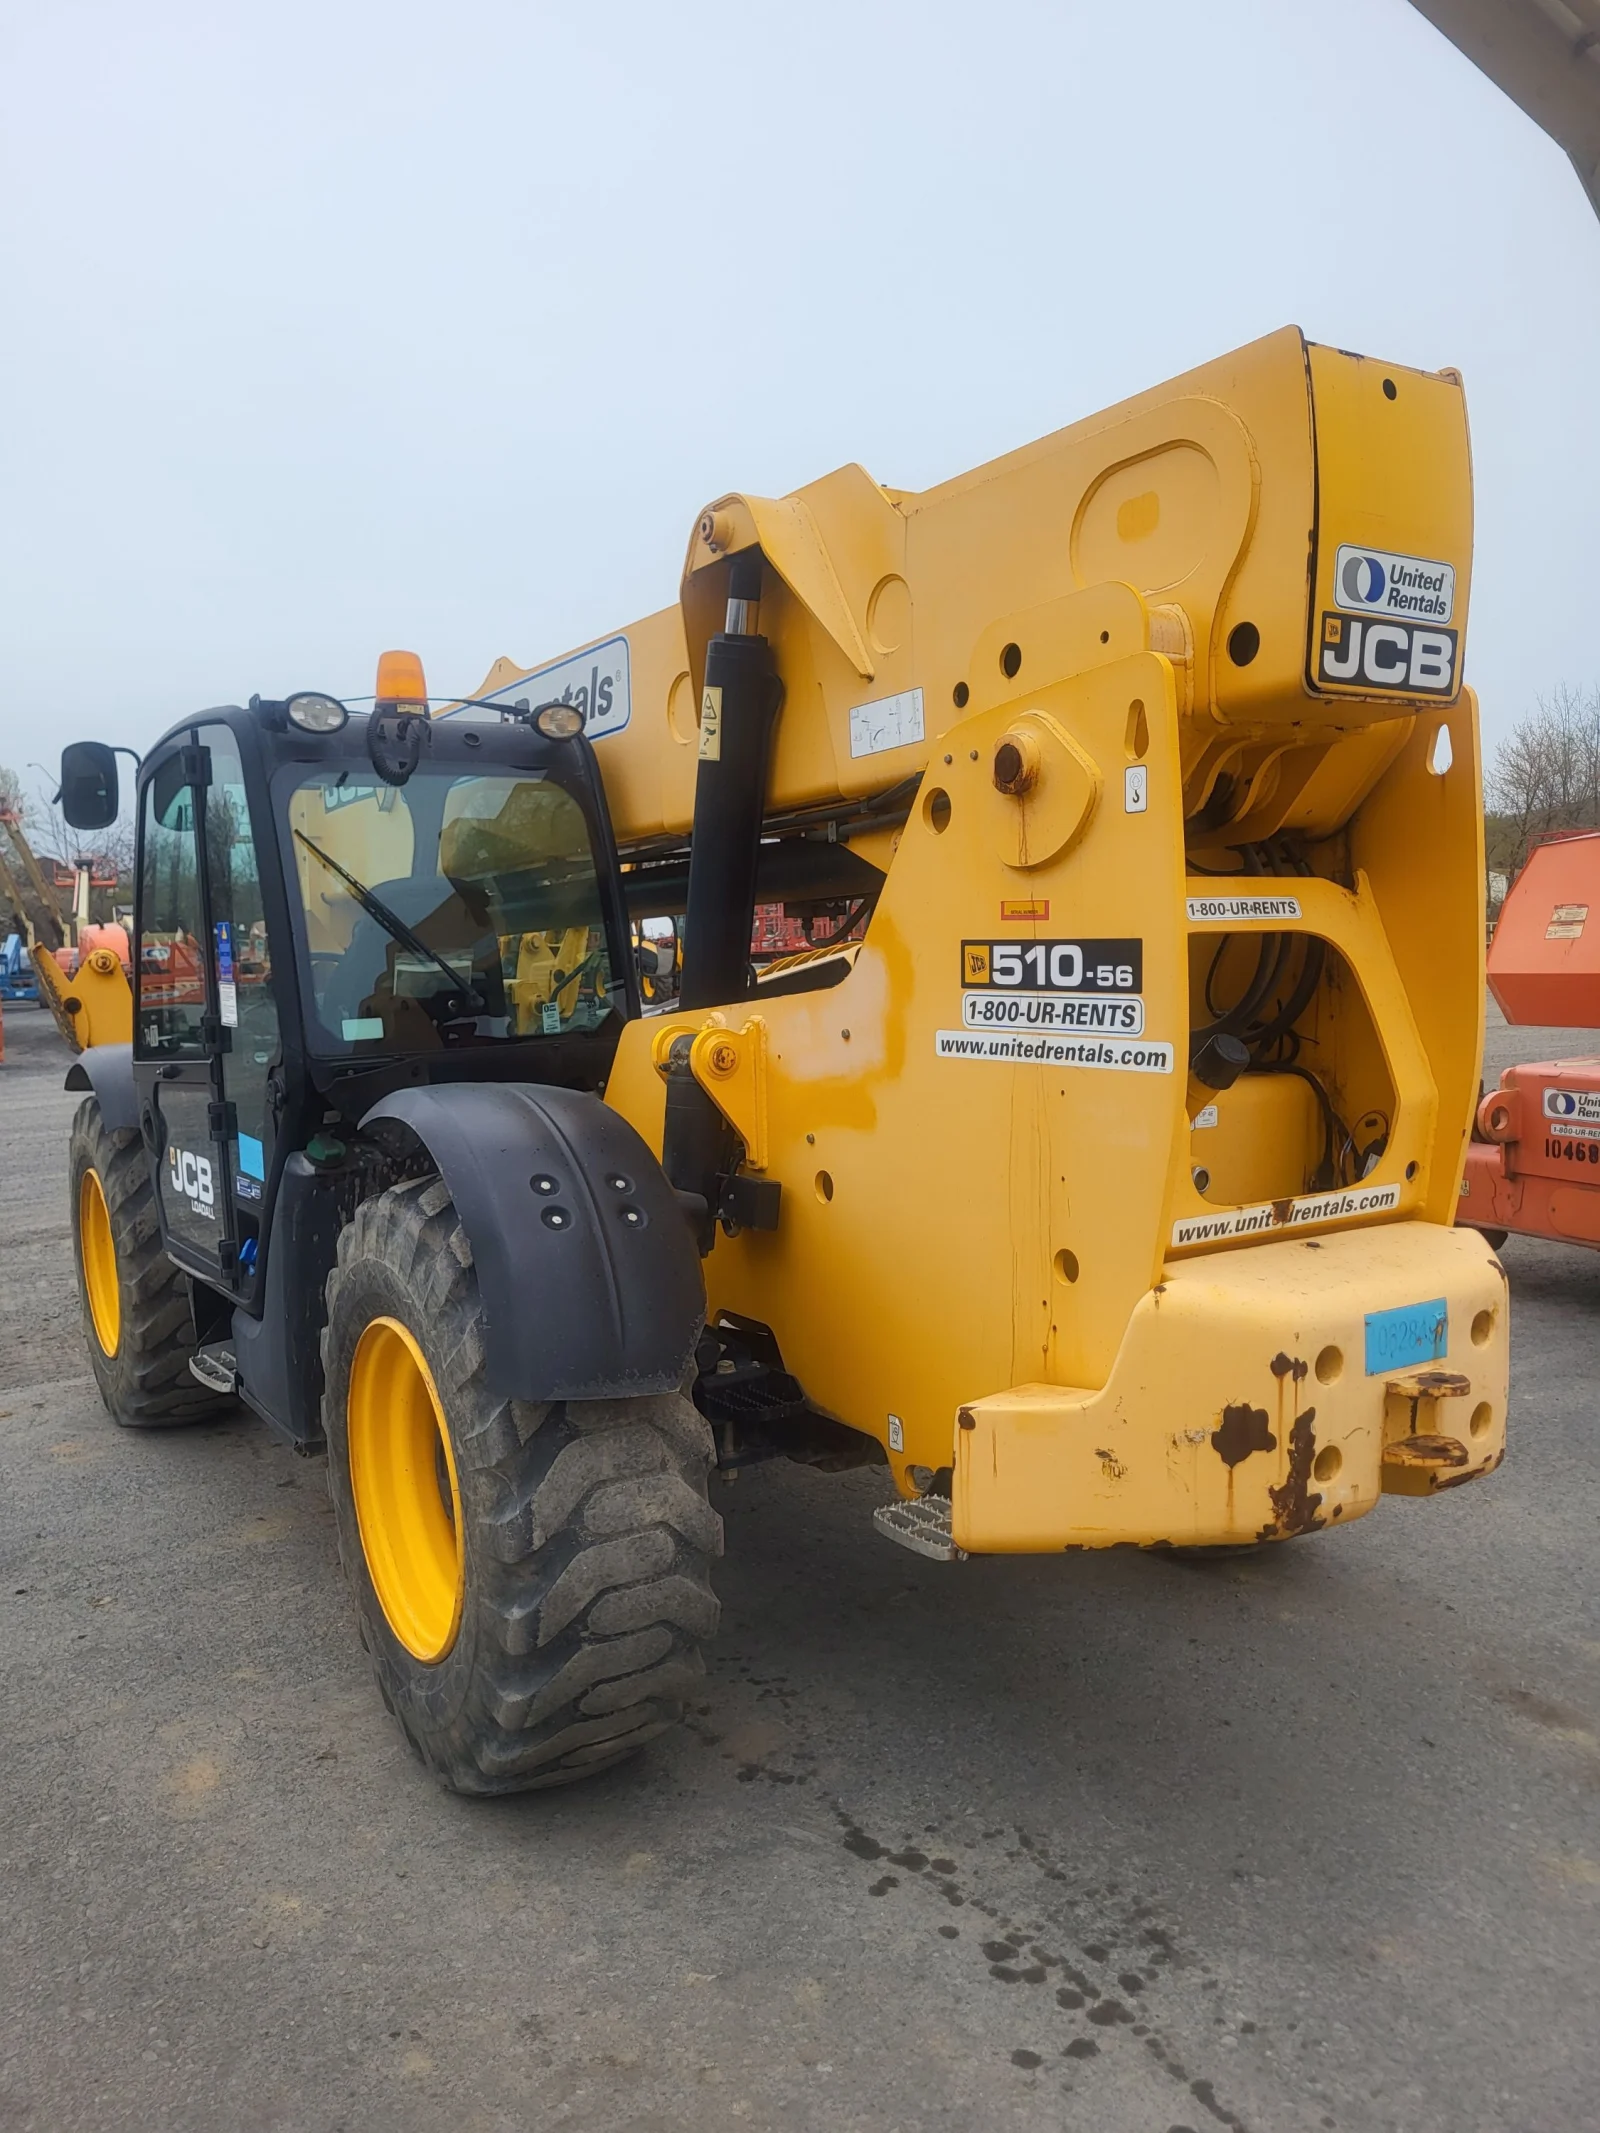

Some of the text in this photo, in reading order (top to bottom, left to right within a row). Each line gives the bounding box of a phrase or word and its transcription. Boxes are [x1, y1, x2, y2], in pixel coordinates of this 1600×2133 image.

[1389, 564, 1445, 592] United
[1387, 587, 1447, 616] Rentals
[1323, 621, 1453, 689] JCB
[1188, 901, 1297, 916] 1-800-UR-RENTS
[968, 1000, 1137, 1028] 1-800-UR-RENTS
[940, 1037, 1168, 1068] www.unitedrentals.com
[171, 1148, 214, 1205] JCB
